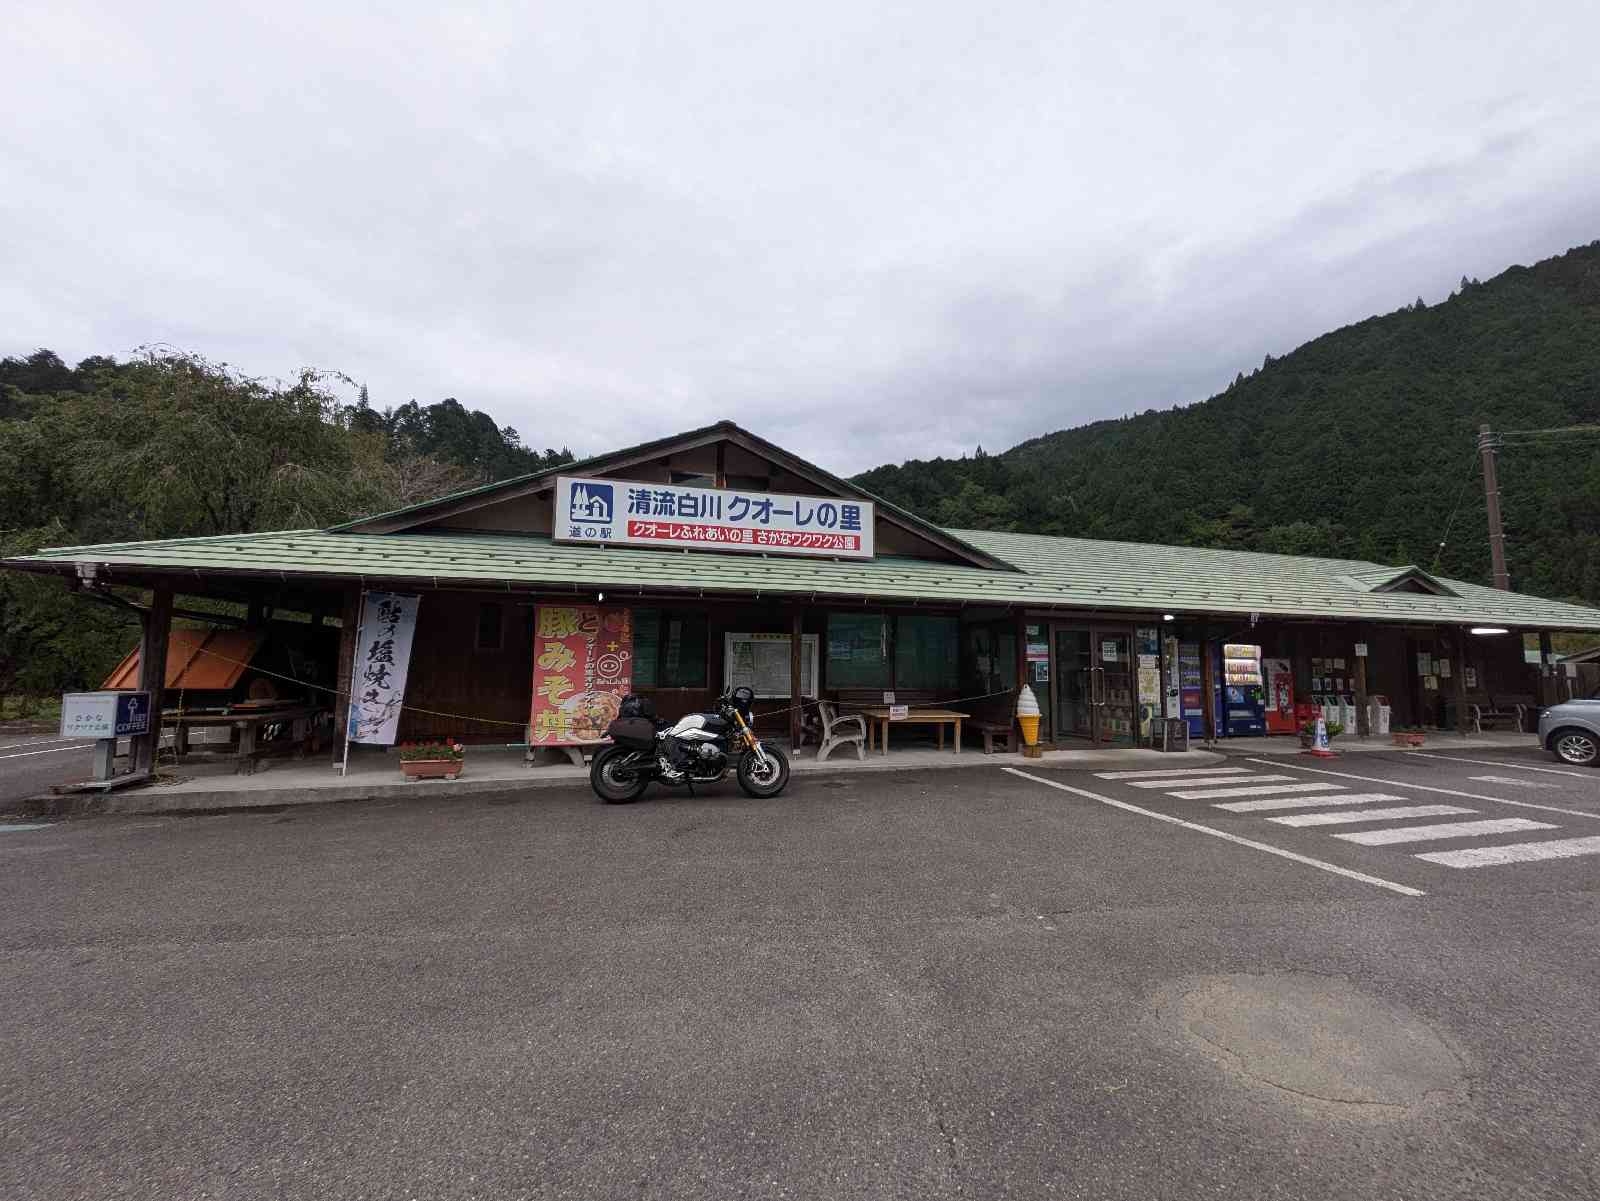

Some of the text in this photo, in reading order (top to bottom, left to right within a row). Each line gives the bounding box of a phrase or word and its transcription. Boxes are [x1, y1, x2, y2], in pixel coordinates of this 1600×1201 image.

[628, 488, 861, 531] 清流白川 クオーレの里
[569, 525, 612, 540] 道の駅
[633, 522, 856, 550] クオーレふれあいの里 さかなワクワク公園
[536, 608, 577, 742] 豚みそ丼
[116, 721, 146, 733] COFFEE
